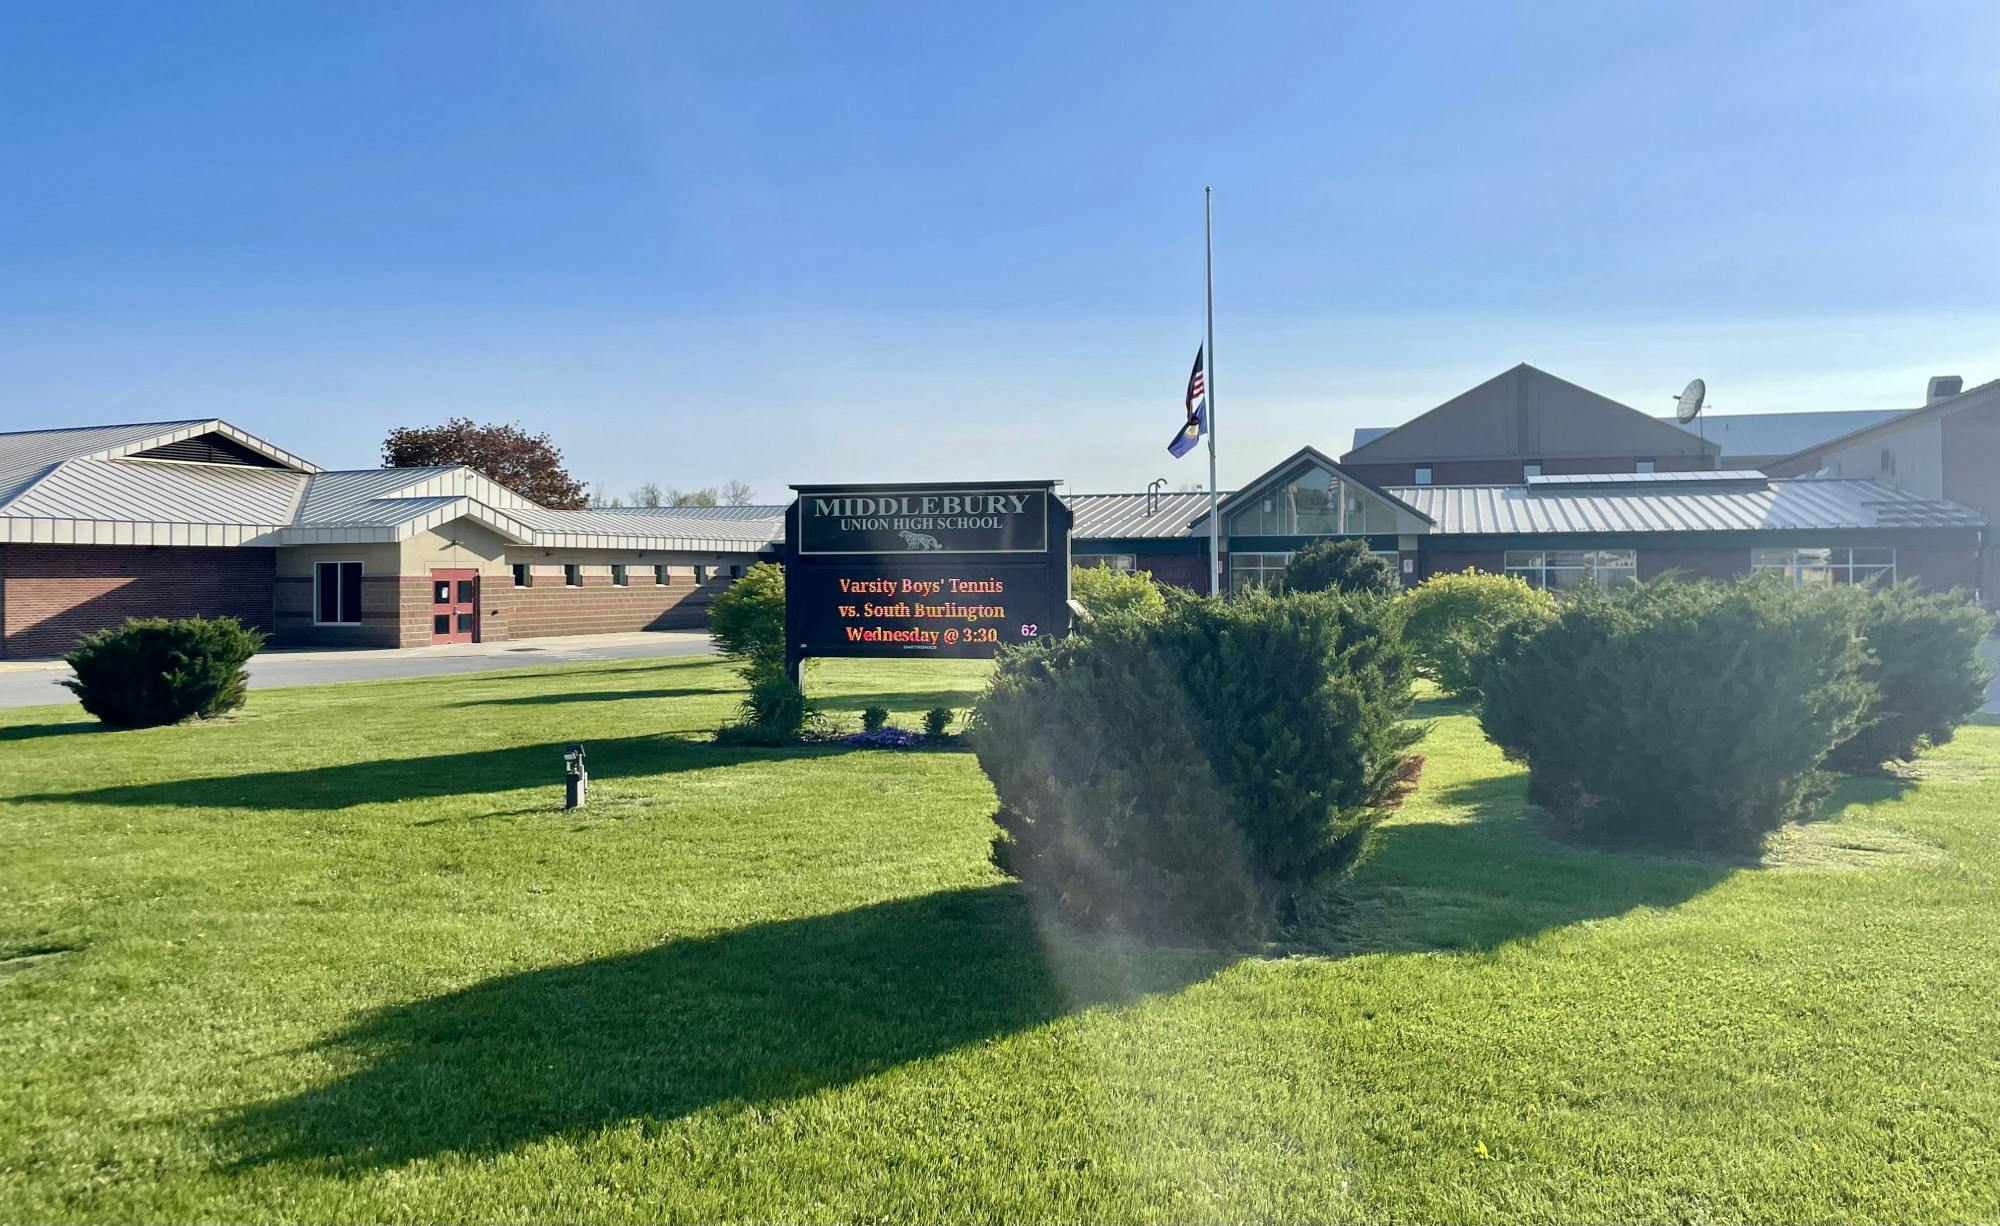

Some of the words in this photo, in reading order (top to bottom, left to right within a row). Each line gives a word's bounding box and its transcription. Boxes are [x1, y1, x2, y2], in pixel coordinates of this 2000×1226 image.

[815, 494, 1032, 517] MIDDLEBURY
[840, 518, 889, 531] UNION
[893, 517, 933, 530] HIGH
[937, 516, 1003, 529] SCHOOL
[839, 578, 898, 597] Varsity
[901, 578, 945, 597] Boys'
[948, 577, 1004, 593] Tennis
[838, 605, 860, 618] vs.
[864, 602, 912, 618] South
[913, 602, 1006, 622] Burlington
[845, 626, 940, 645] Wednesday
[943, 628, 960, 645] @
[962, 628, 998, 643] 3:30
[1020, 624, 1038, 637] 62
